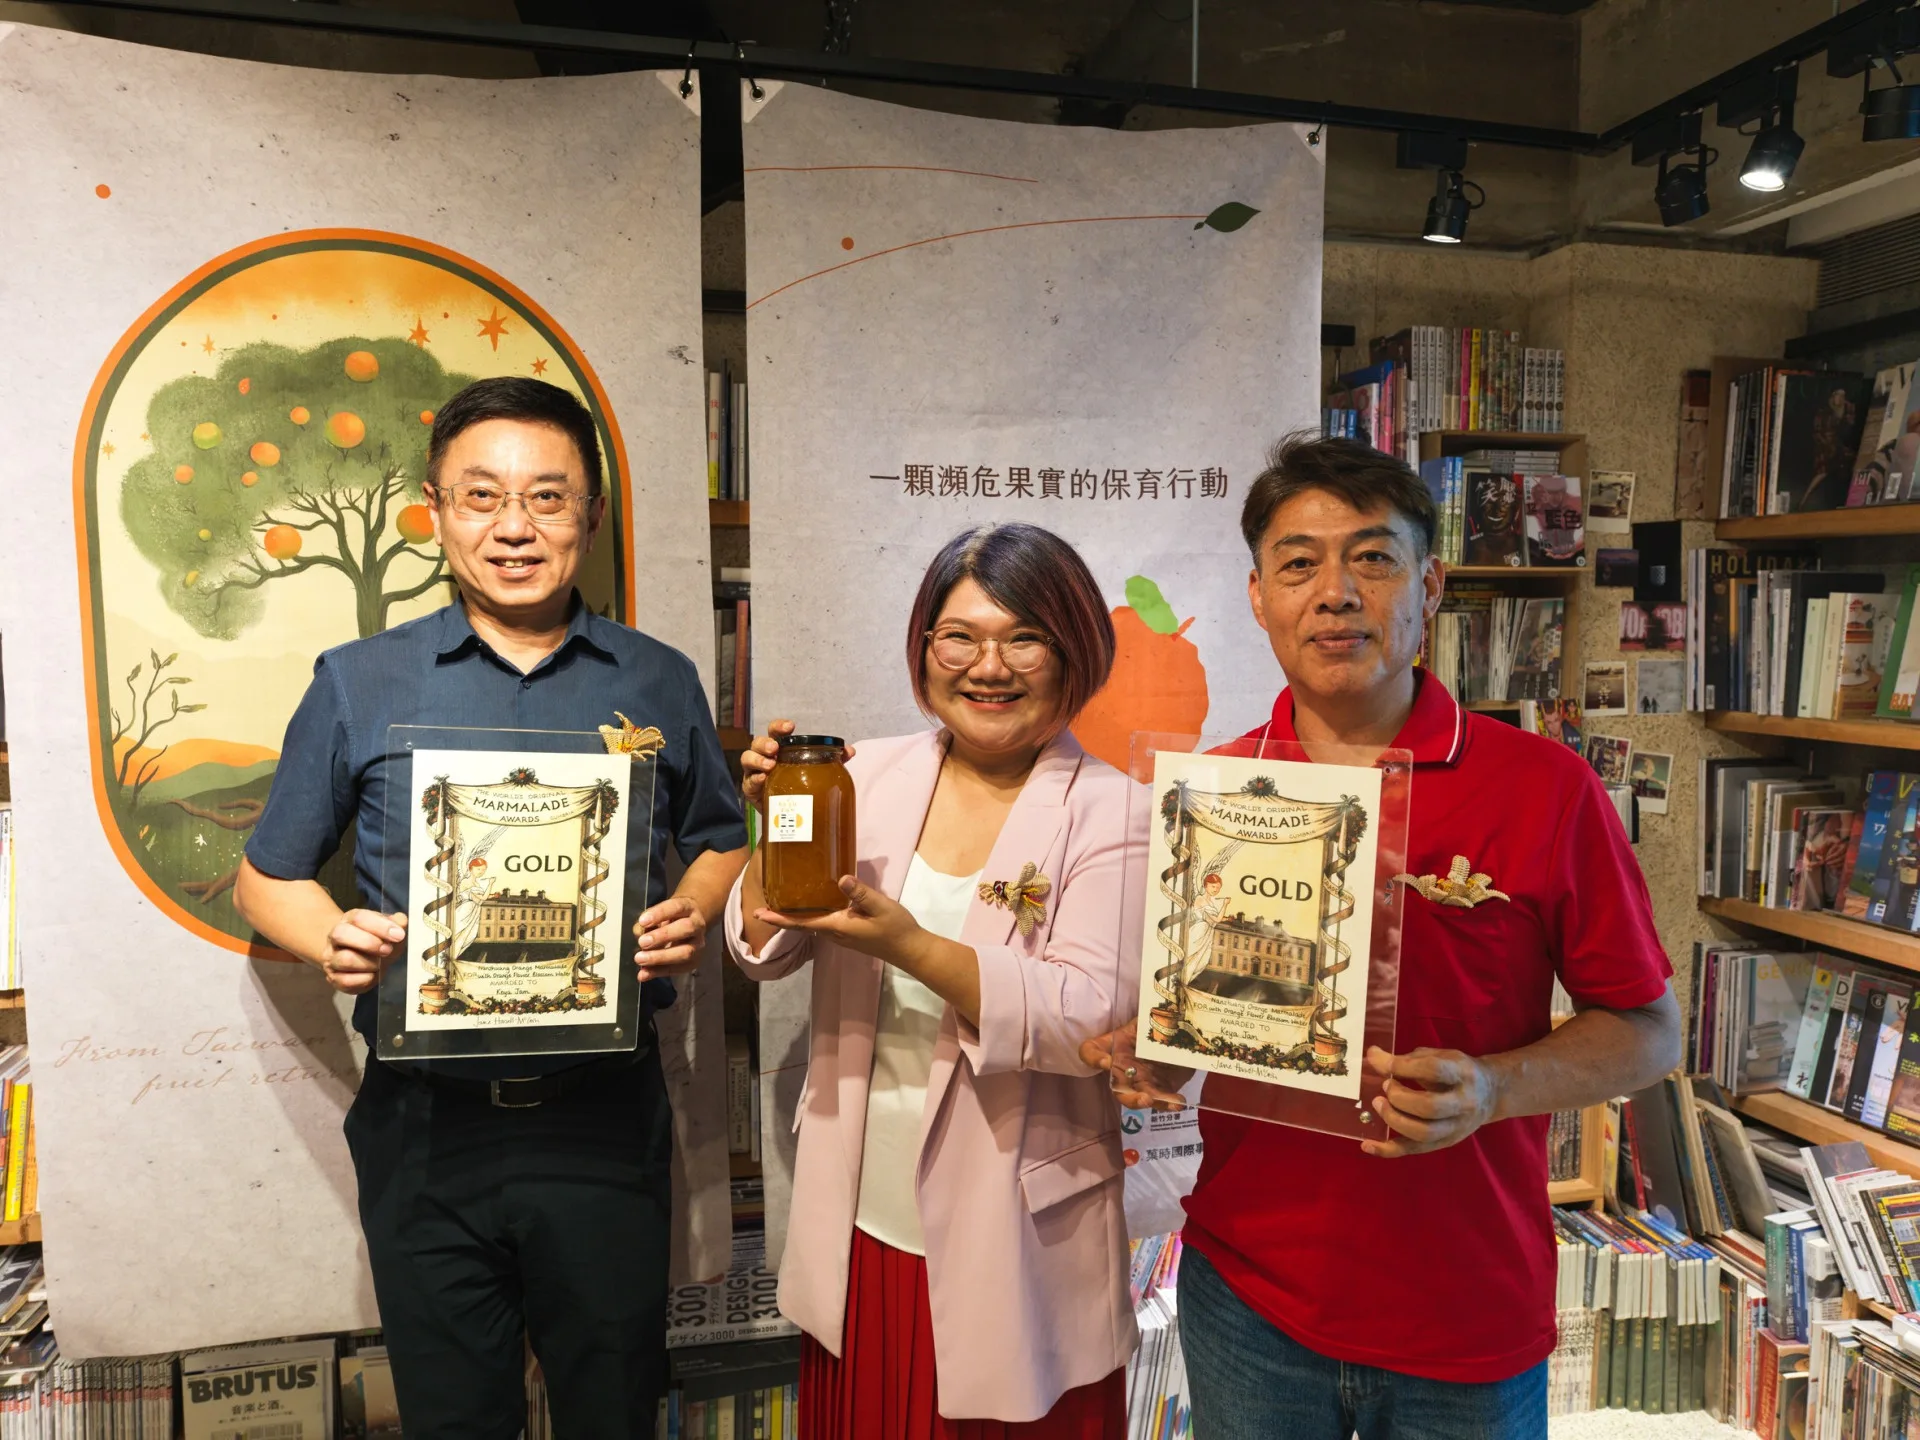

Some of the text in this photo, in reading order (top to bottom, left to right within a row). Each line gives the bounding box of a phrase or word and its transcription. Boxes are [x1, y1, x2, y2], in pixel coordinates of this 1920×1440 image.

[869, 463, 1228, 500] 一顆瀕危果實的保育行動
[473, 796, 570, 813] MARMALADE
[1266, 805, 1308, 813] ORIGINAL
[499, 815, 540, 823] AWARDS
[1210, 805, 1311, 828] MARMALADE
[1236, 829, 1278, 840] AWARDS
[504, 855, 573, 873] GOLD
[1239, 875, 1313, 902] GOLD
[1193, 1002, 1208, 1010] FOR
[1247, 1003, 1268, 1013] Orange
[1220, 1018, 1255, 1029] AWARDED
[181, 1026, 326, 1056] Taiwan
[1220, 1027, 1258, 1040] Keya Jam
[726, 1267, 750, 1324] DESIGN
[187, 1363, 319, 1404] BRUTUS
